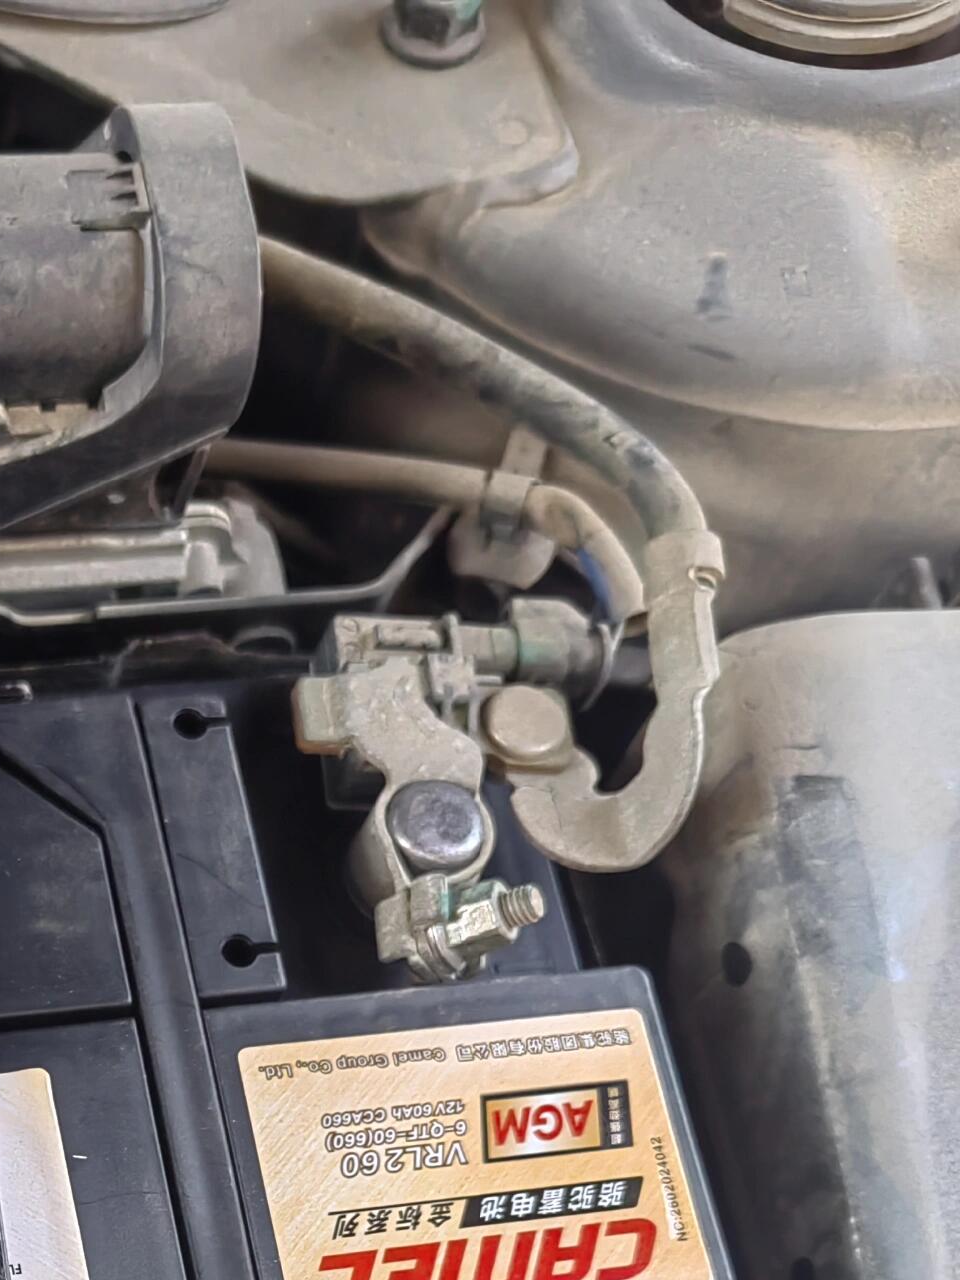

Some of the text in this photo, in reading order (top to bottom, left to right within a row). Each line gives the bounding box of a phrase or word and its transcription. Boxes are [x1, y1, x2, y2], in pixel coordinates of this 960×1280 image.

[336, 1053, 388, 1070] Group
[393, 1047, 446, 1065] Camel
[455, 1028, 631, 1063] 骆驼集团股份有限公司
[258, 1063, 292, 1080] Ltd.
[321, 1107, 387, 1128] CCA660
[492, 1100, 593, 1147] AGM
[325, 1120, 467, 1152] 6-QTF-60(660)
[340, 1140, 467, 1178] VRL2 60
[332, 1181, 626, 1240] 骆驼蓄电池 金标系列
